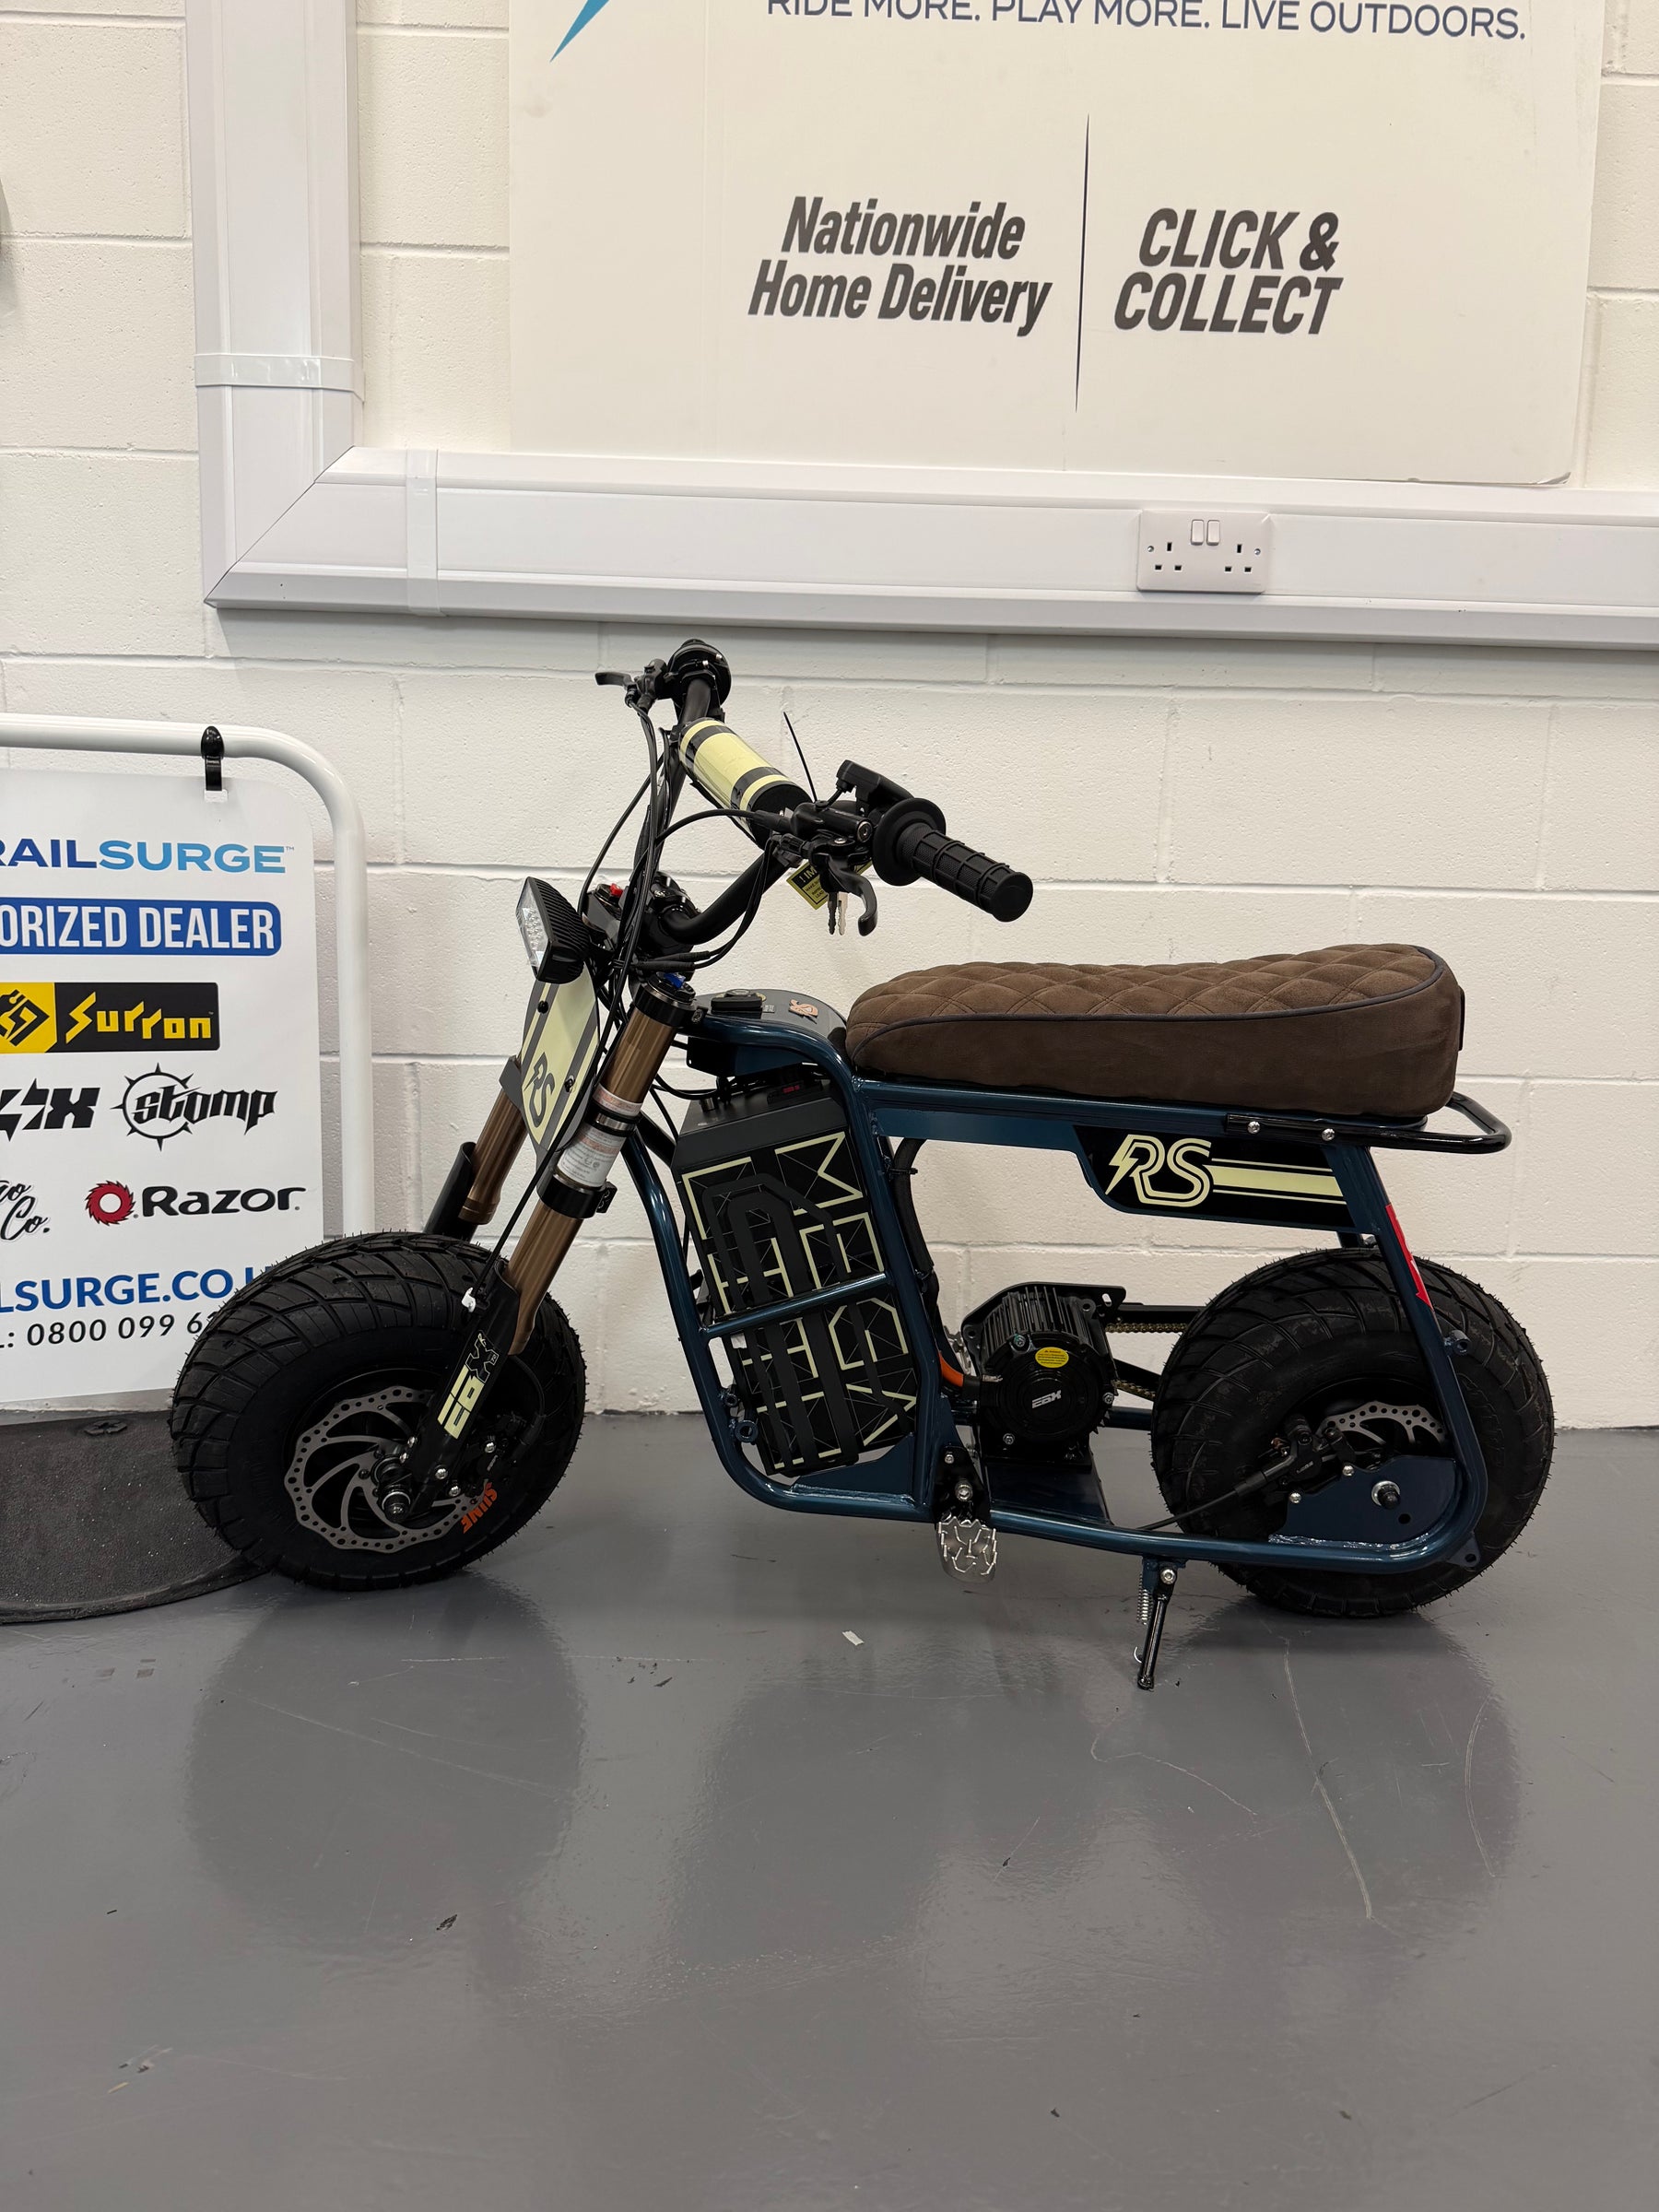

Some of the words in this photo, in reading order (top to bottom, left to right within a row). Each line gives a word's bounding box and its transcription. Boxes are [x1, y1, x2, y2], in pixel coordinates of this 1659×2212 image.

[864, 0, 981, 21] MORE.
[992, 0, 1082, 24] PLAY
[1094, 0, 1210, 29] MORE.
[1221, 0, 1300, 30] LIVE
[1310, 0, 1525, 40] OUTDOORS.
[780, 196, 1025, 260] Nationwide
[1139, 208, 1296, 269] CLICK
[1300, 212, 1340, 272] &
[748, 260, 868, 319] Home
[878, 264, 1053, 337] Delivery
[1114, 273, 1344, 335] COLLECT
[0, 904, 127, 947] ORIZED
[139, 906, 276, 949] DEALER
[142, 1186, 306, 1216] Razor
[1105, 1134, 1212, 1207] RS
[28, 1320, 106, 1346] 0800
[118, 1314, 175, 1339] 099
